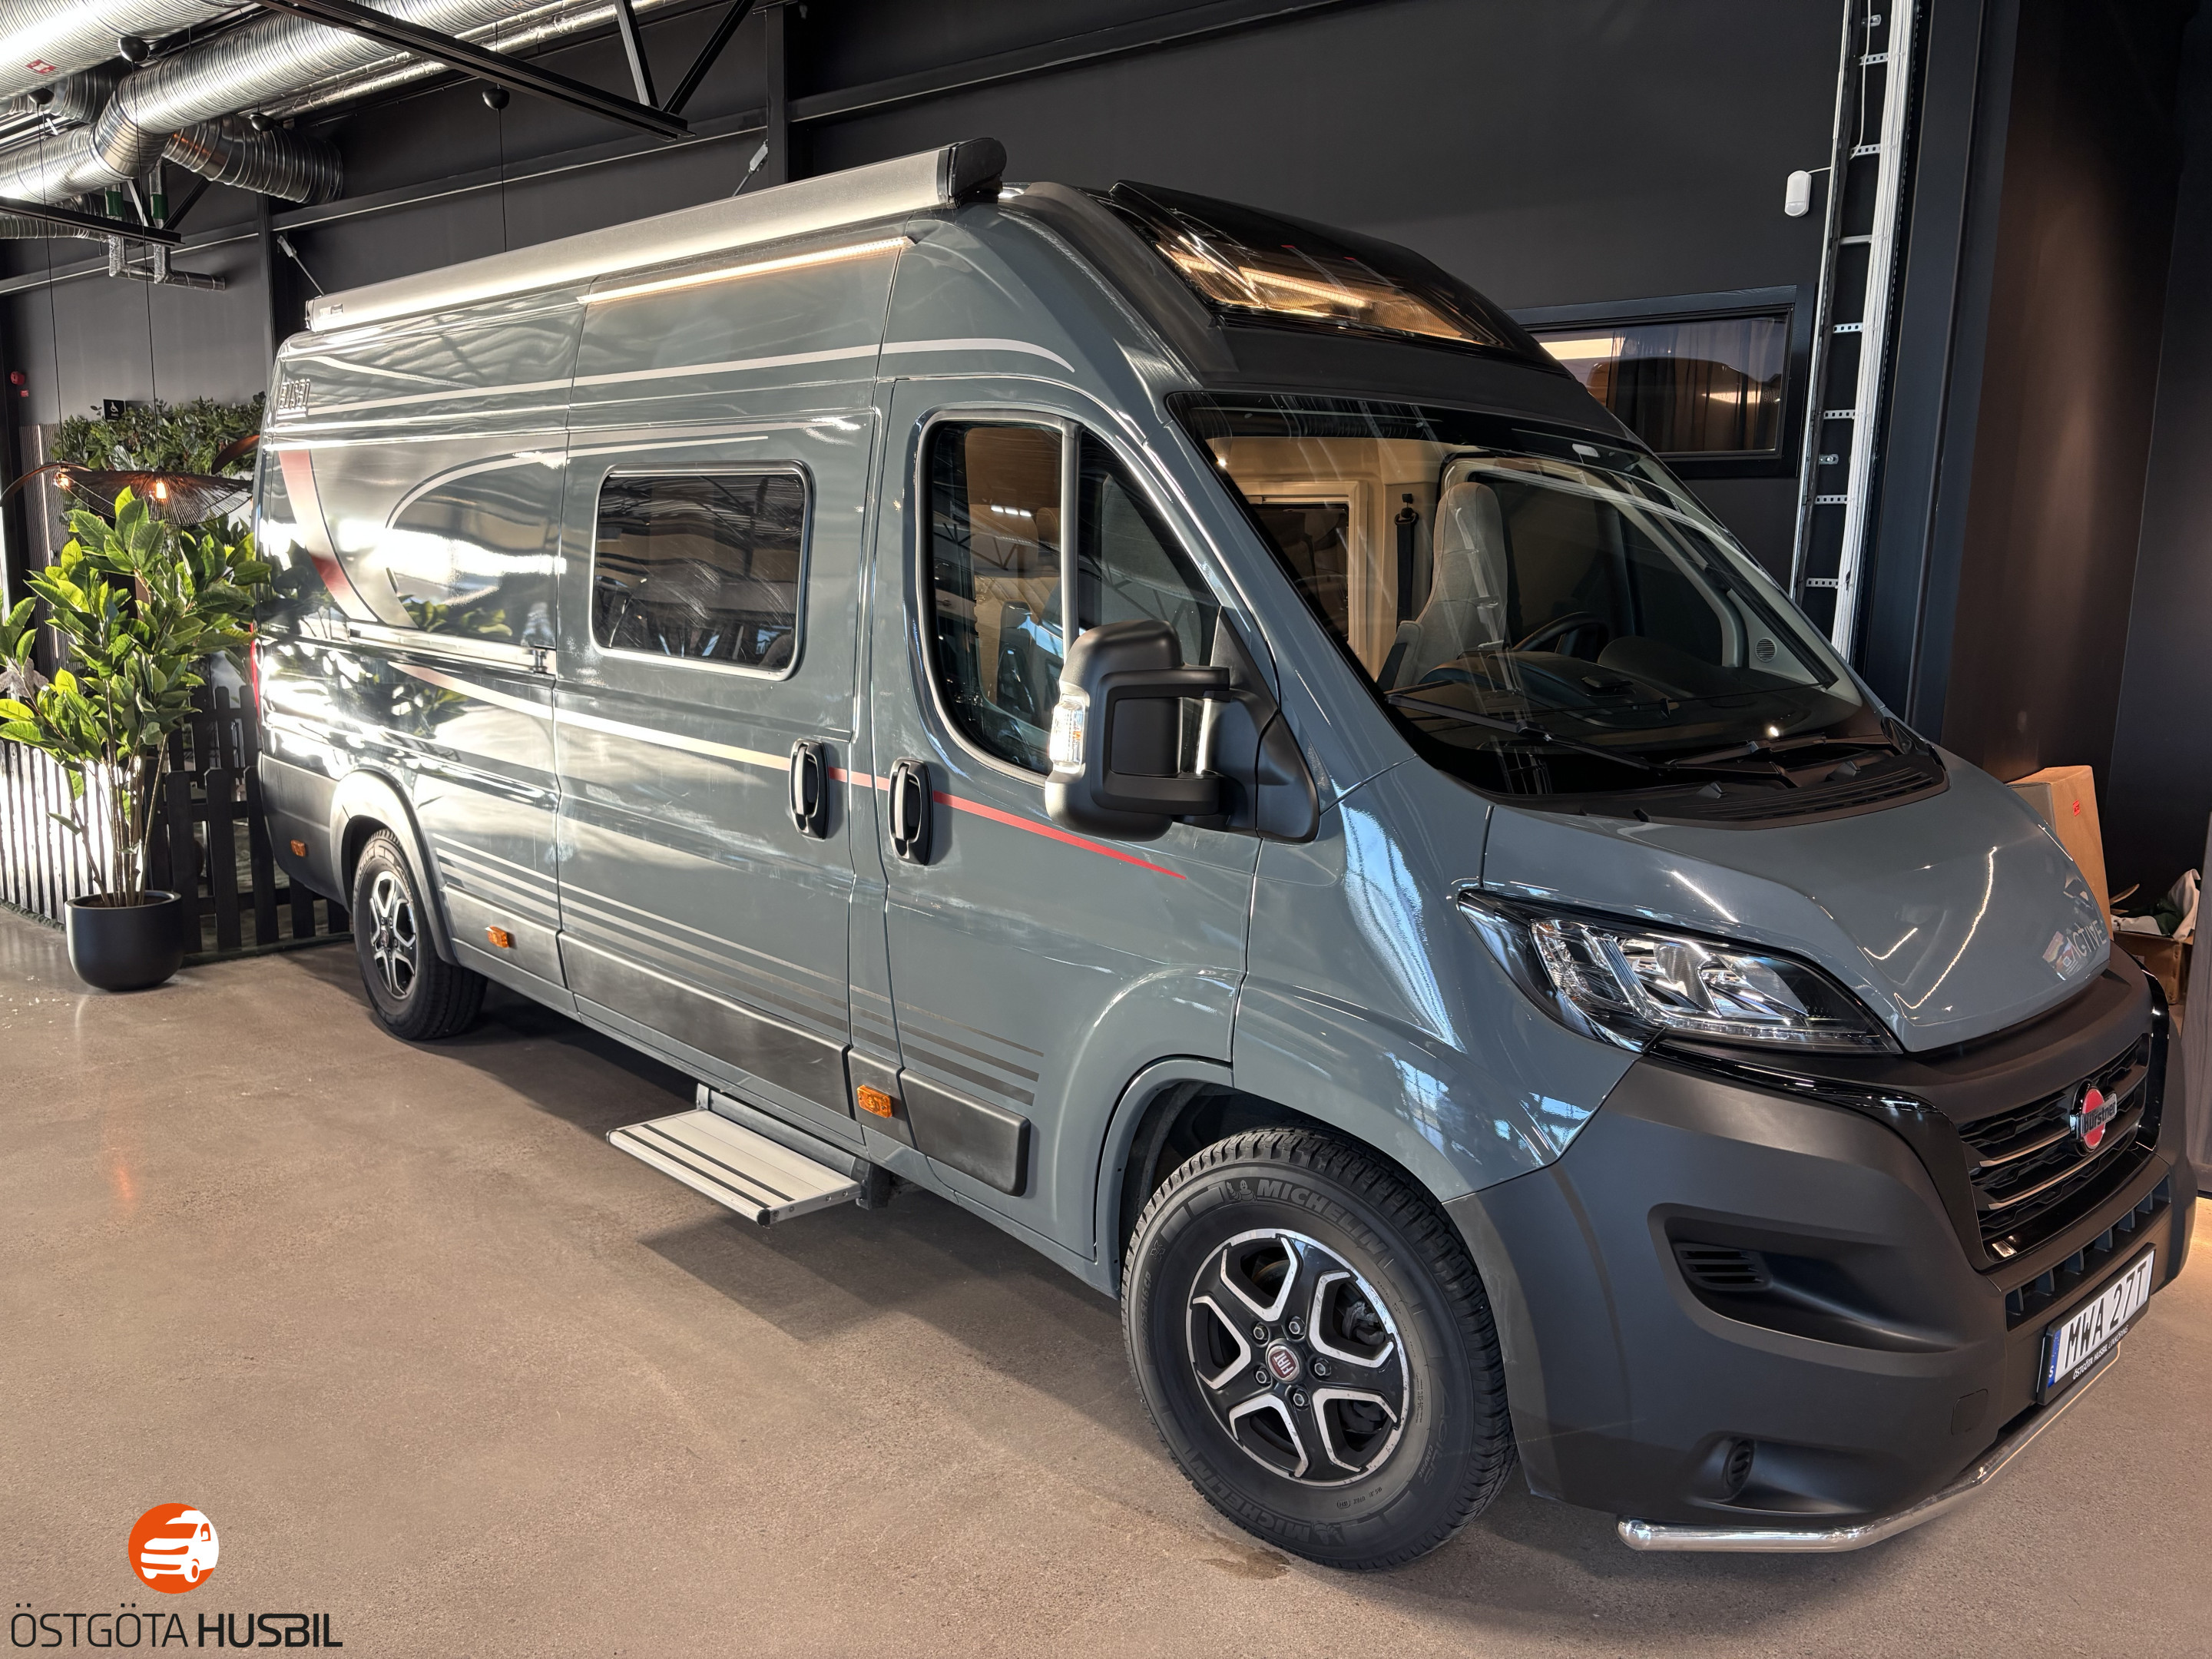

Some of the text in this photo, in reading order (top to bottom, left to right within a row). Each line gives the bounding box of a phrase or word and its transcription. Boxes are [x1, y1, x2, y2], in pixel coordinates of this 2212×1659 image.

[2066, 919, 2107, 960] ACTIVE
[1257, 1179, 1388, 1255] MICHELIN
[2065, 1261, 2147, 1369] MWA 27T
[1273, 1353, 1294, 1376] FIAT
[2048, 1366, 2055, 1378] S
[1419, 1444, 1434, 1479] CAMPING
[1190, 1459, 1311, 1542] MICHELIN
